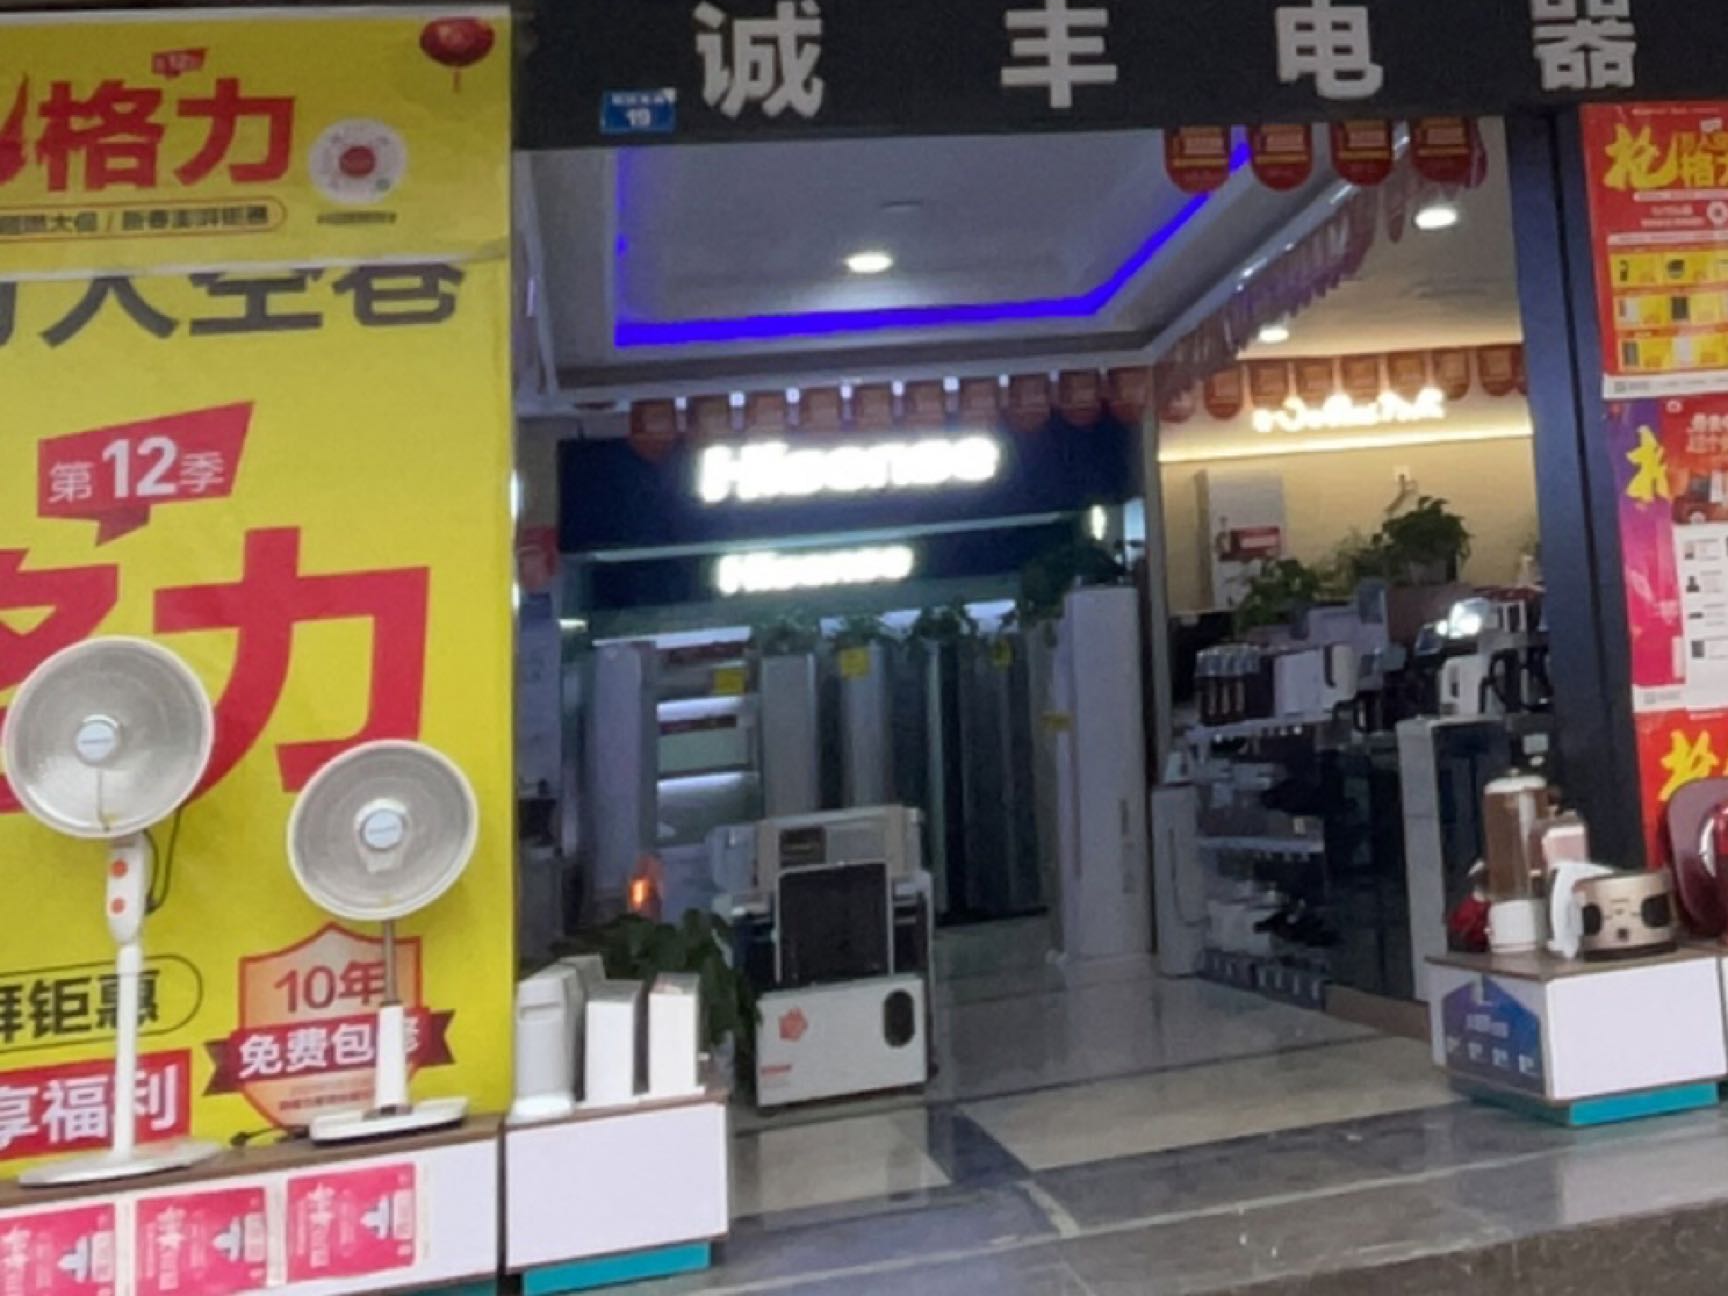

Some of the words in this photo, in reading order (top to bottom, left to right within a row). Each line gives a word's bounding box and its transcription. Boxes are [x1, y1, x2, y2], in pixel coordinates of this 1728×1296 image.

[0, 72, 297, 192] 格力
[48, 436, 225, 504] 第12季
[273, 960, 387, 1013] 10年
